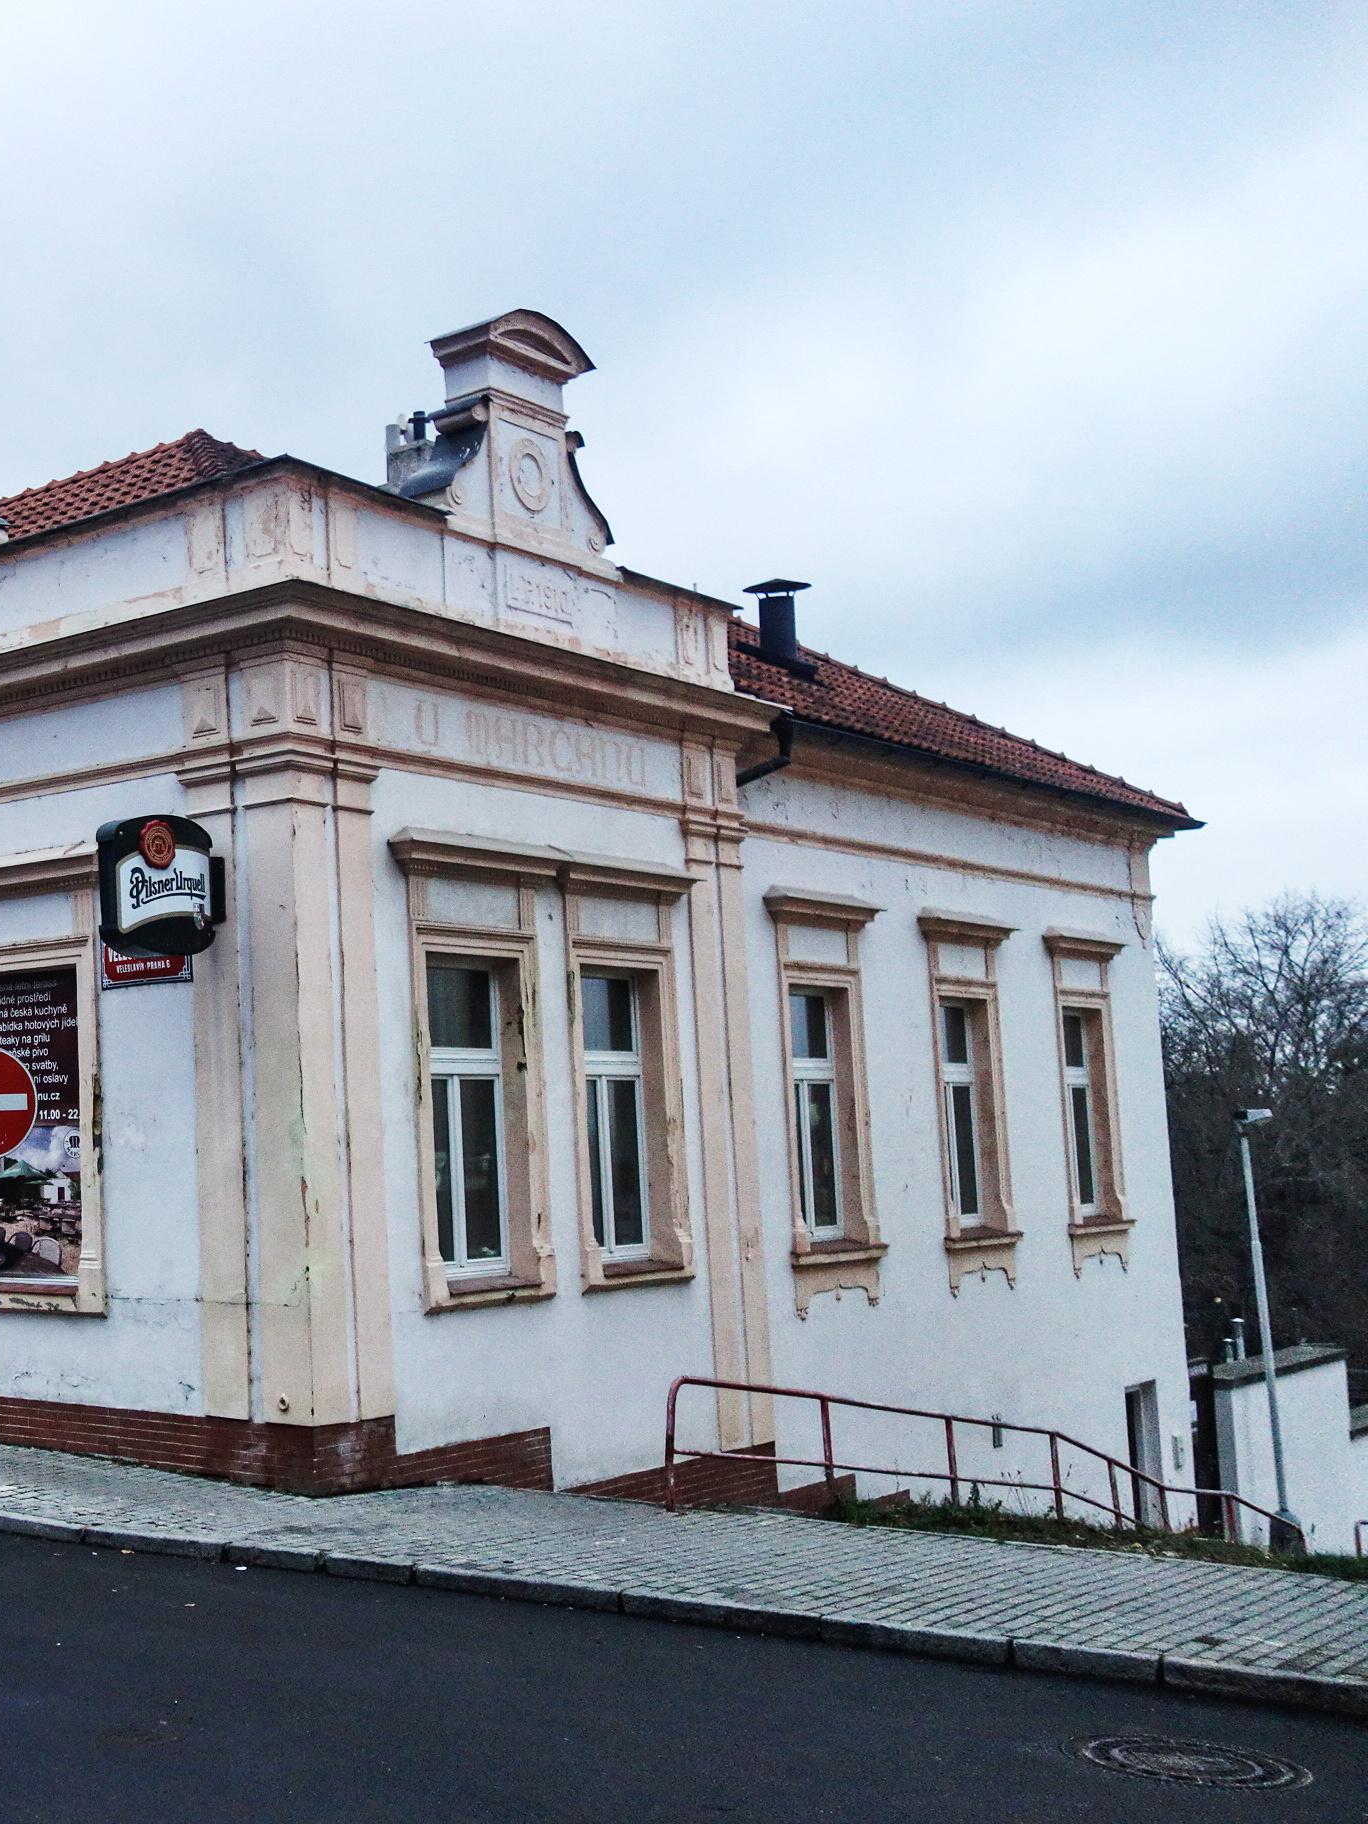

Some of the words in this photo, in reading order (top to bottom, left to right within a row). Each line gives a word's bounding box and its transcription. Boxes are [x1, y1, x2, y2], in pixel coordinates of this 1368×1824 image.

[414, 700, 439, 746] U
[129, 866, 175, 909] Pilsner
[173, 868, 206, 900] Urquell
[146, 960, 165, 971] PRAHA
[17, 991, 51, 1006] prostředí
[10, 1007, 33, 1018] česká
[34, 1003, 68, 1018] kuchyně
[24, 1018, 60, 1032] hotových
[21, 1035, 32, 1044] na
[33, 1032, 51, 1046] grilu
[32, 1046, 49, 1058] pivo
[42, 1074, 69, 1085] oslavy
[39, 1109, 61, 1120] 11.00
